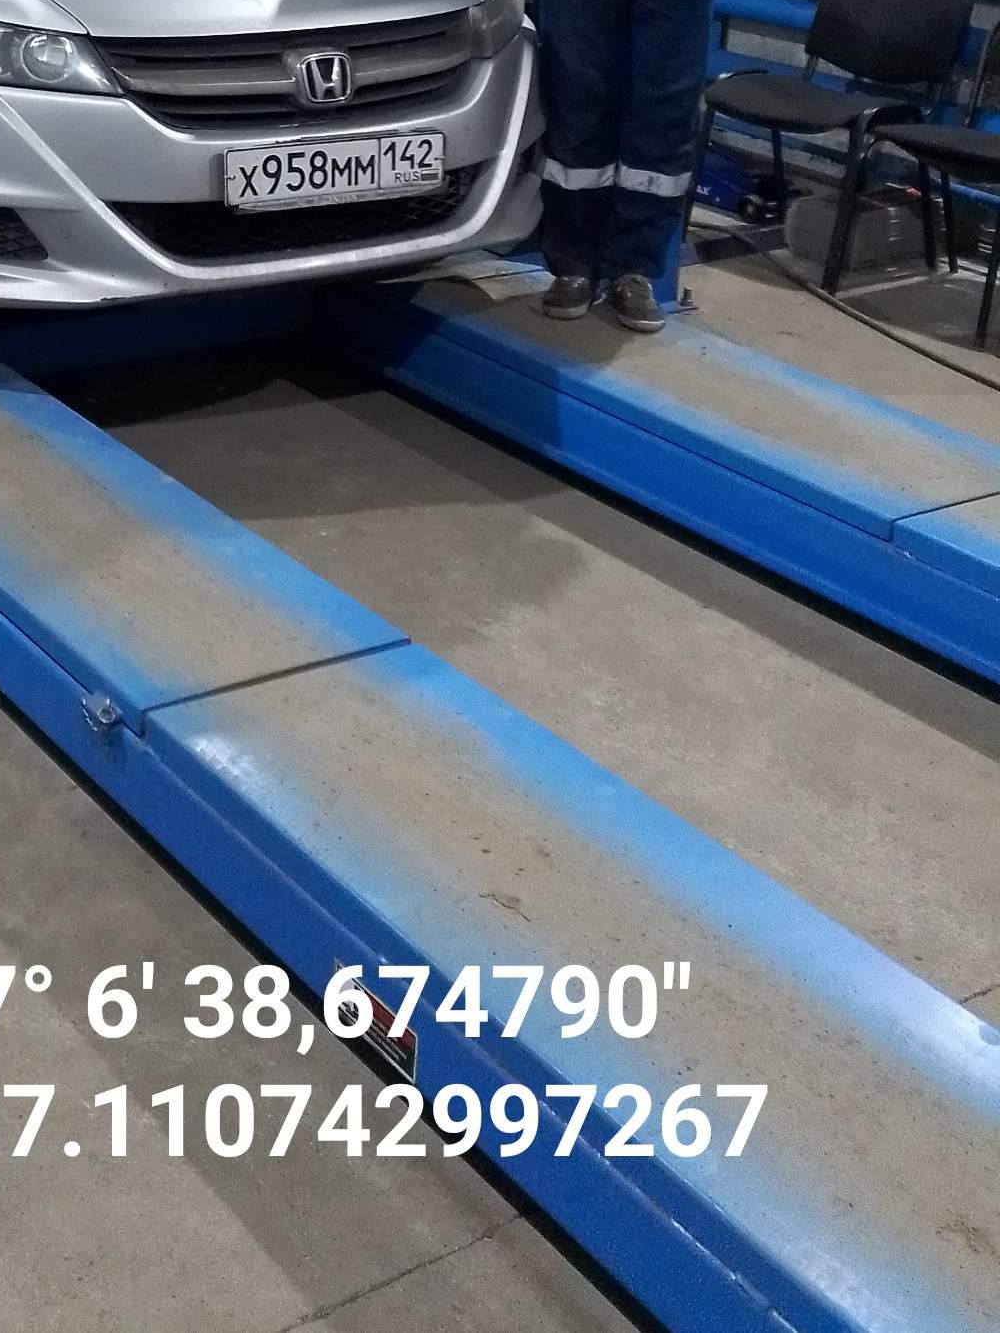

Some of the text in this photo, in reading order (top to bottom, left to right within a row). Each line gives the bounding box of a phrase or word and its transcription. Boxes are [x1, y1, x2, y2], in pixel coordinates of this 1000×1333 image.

[238, 138, 434, 198] Х958ММ 142
[394, 170, 421, 184] RUS
